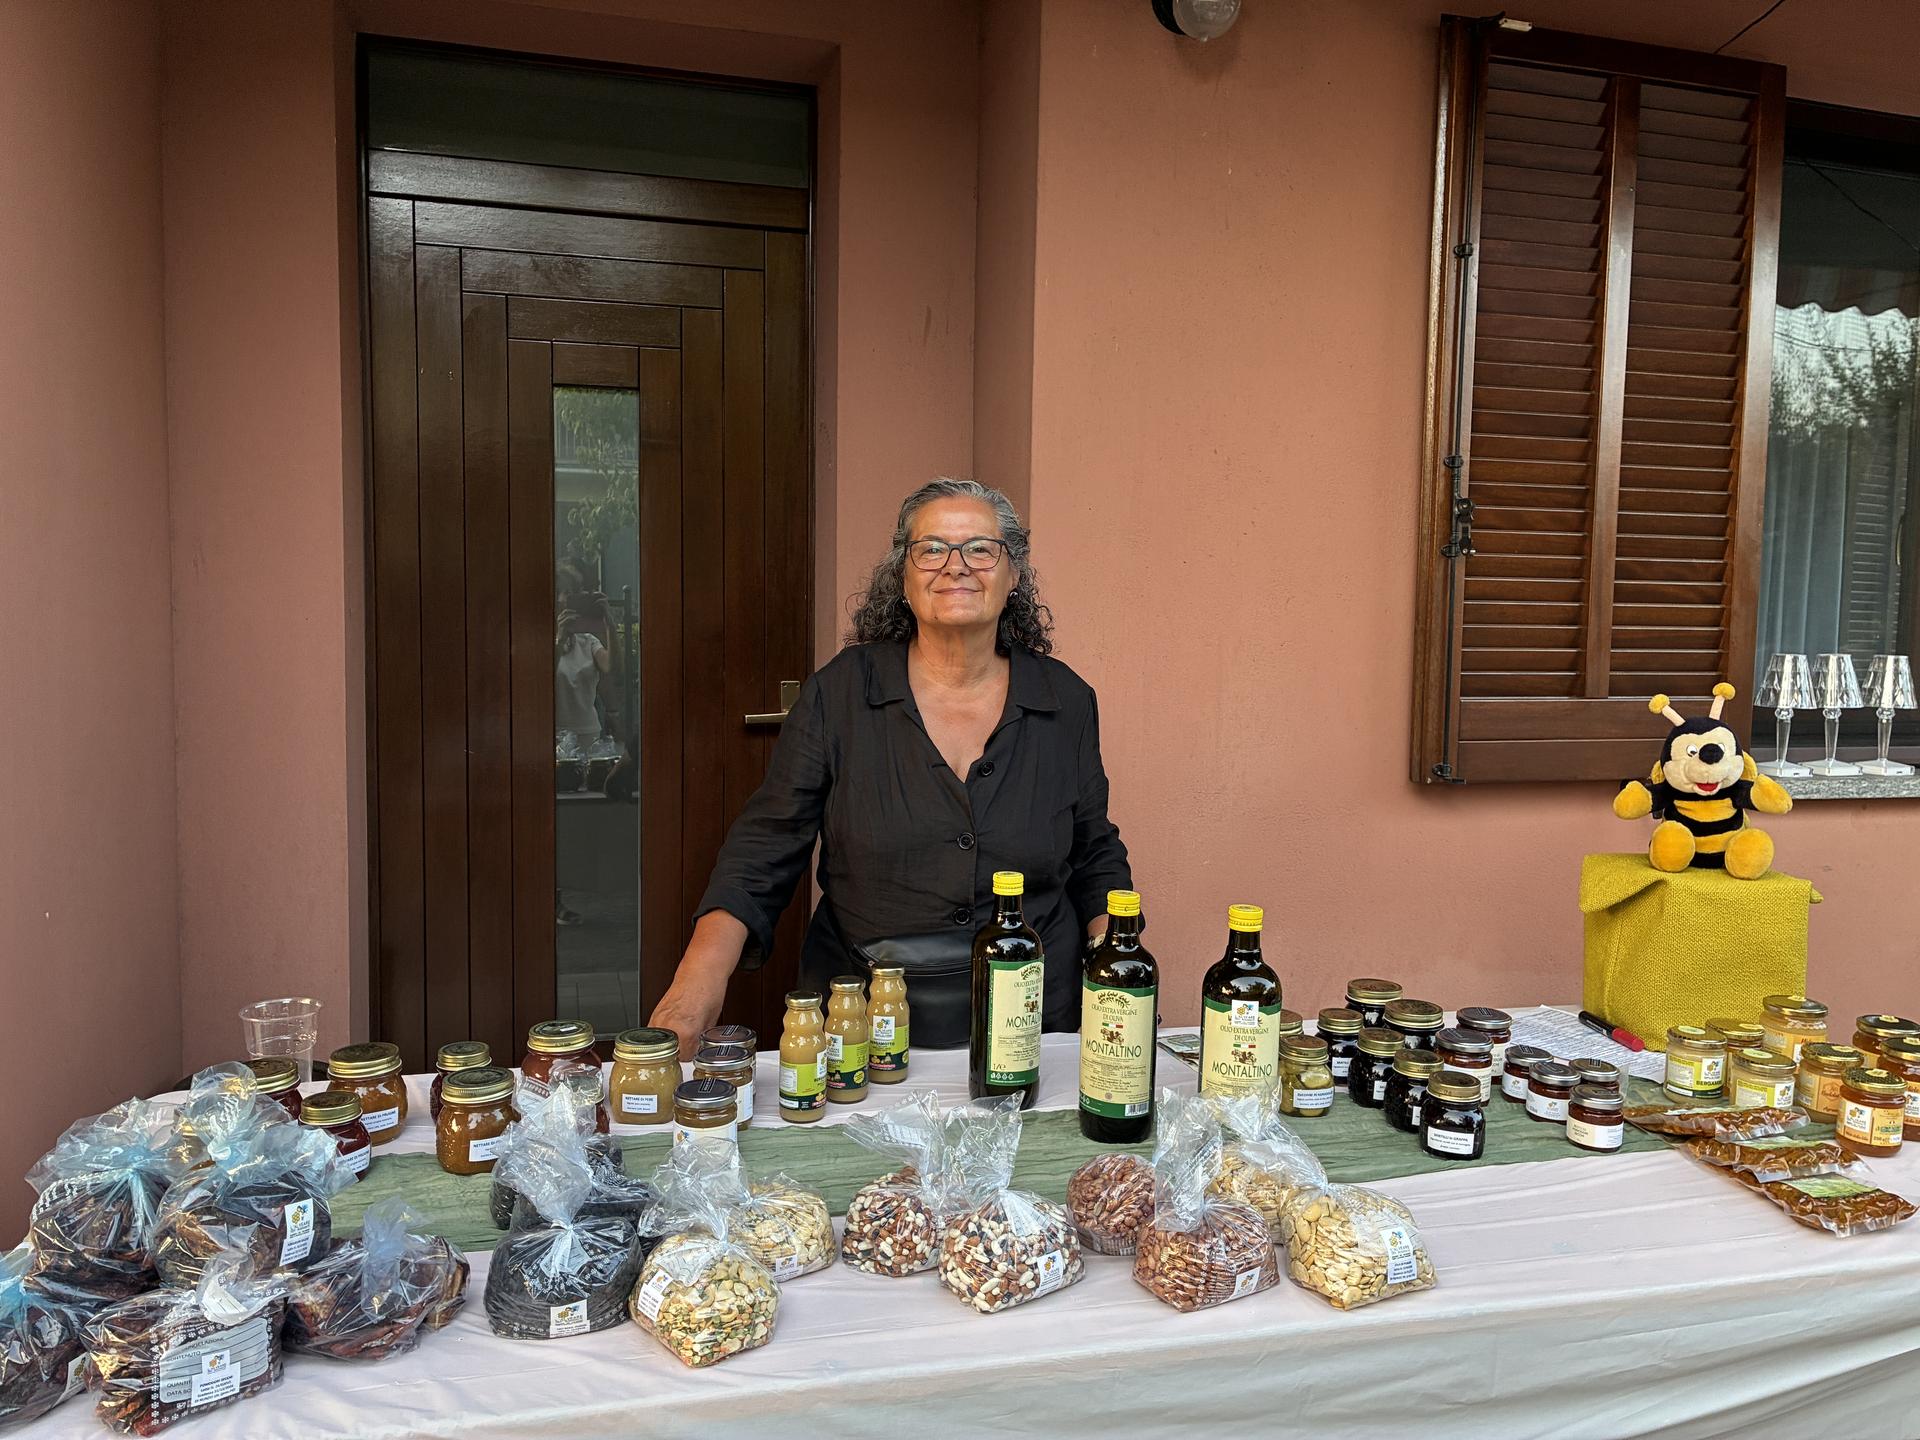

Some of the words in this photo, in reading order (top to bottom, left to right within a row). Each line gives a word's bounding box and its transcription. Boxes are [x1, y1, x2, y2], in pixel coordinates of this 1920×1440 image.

[1091, 1003, 1102, 1012] OLIO
[1102, 1006, 1117, 1016] EXTRA
[1117, 1007, 1138, 1017] VERGINE
[1249, 1027, 1269, 1035] VERGINE
[1086, 1038, 1142, 1058] MONTALTINO
[1212, 1060, 1273, 1078] MONTALTINO
